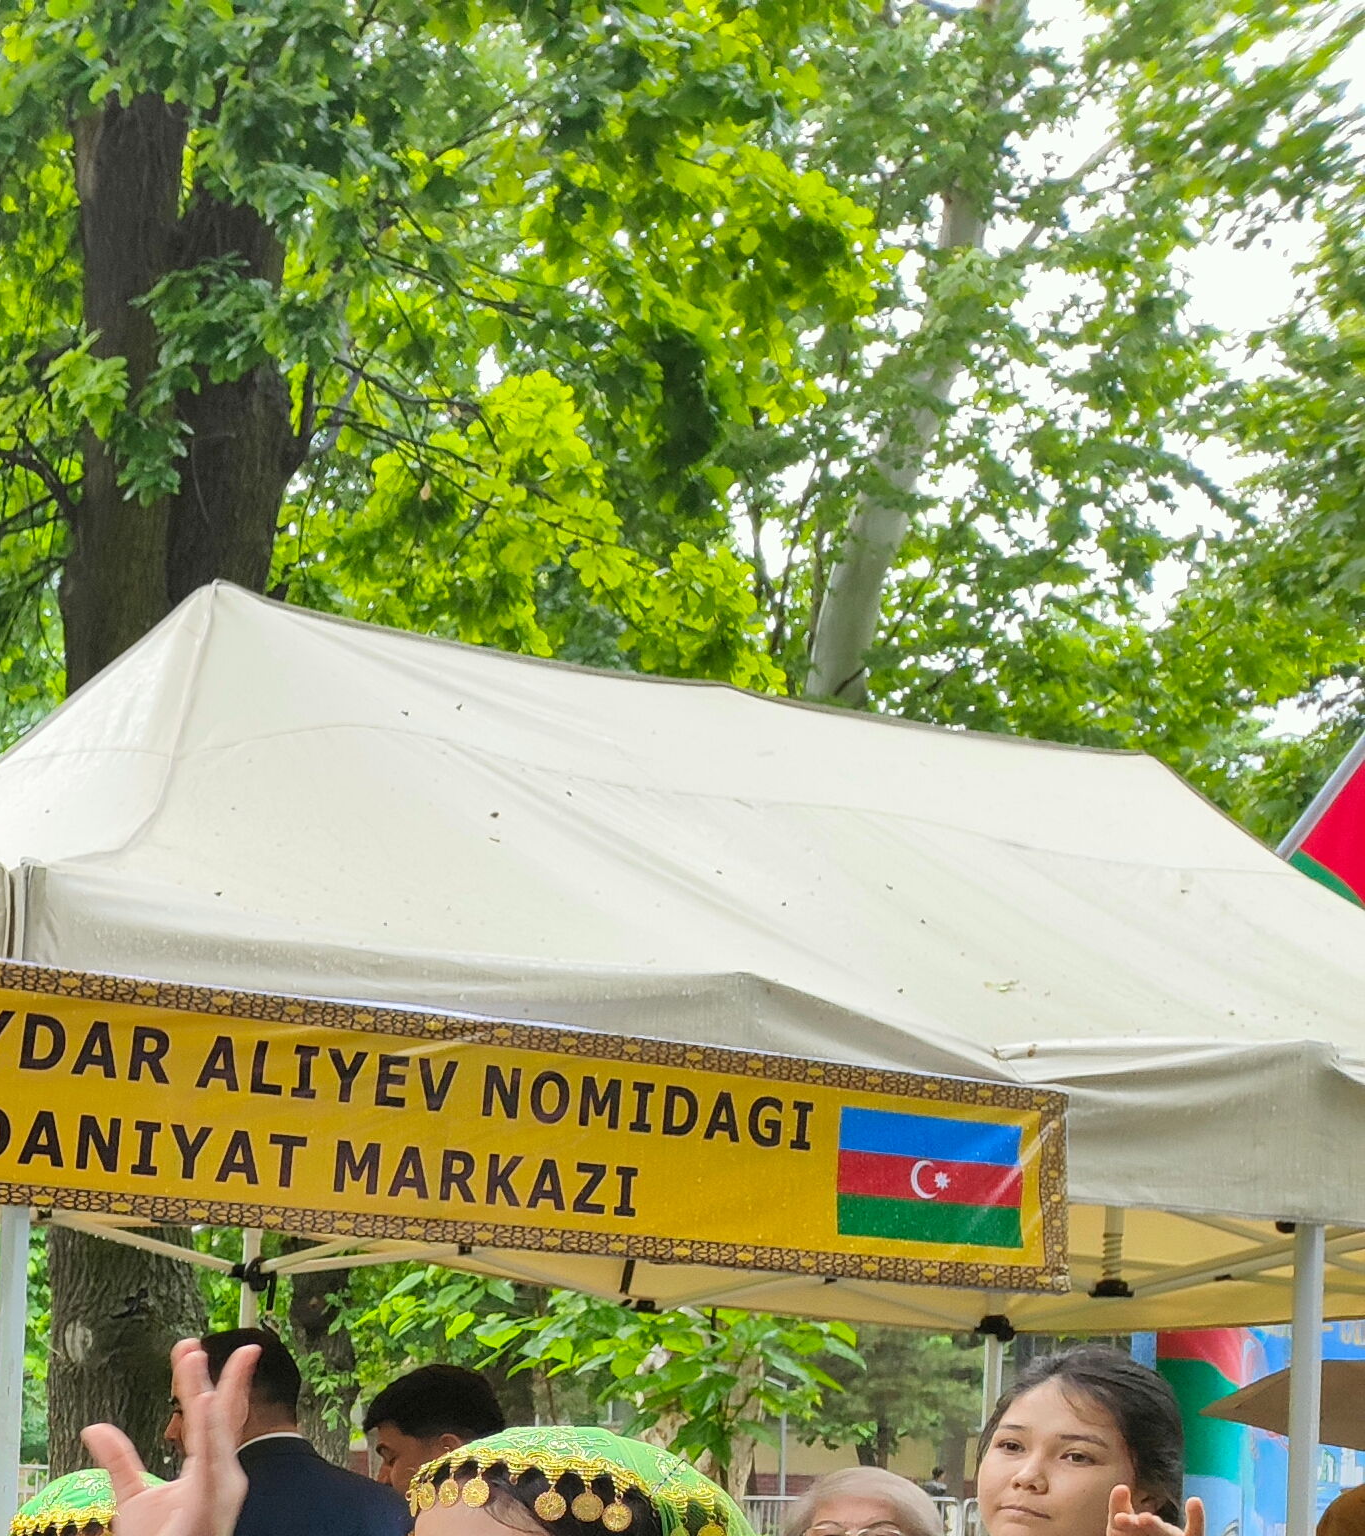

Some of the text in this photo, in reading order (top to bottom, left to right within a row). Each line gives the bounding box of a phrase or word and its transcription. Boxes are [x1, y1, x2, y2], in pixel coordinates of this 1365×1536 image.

[195, 1034, 460, 1113] ALIYEV
[480, 1064, 815, 1151] NOMIDAGI
[332, 1140, 639, 1218] MARKAZI
